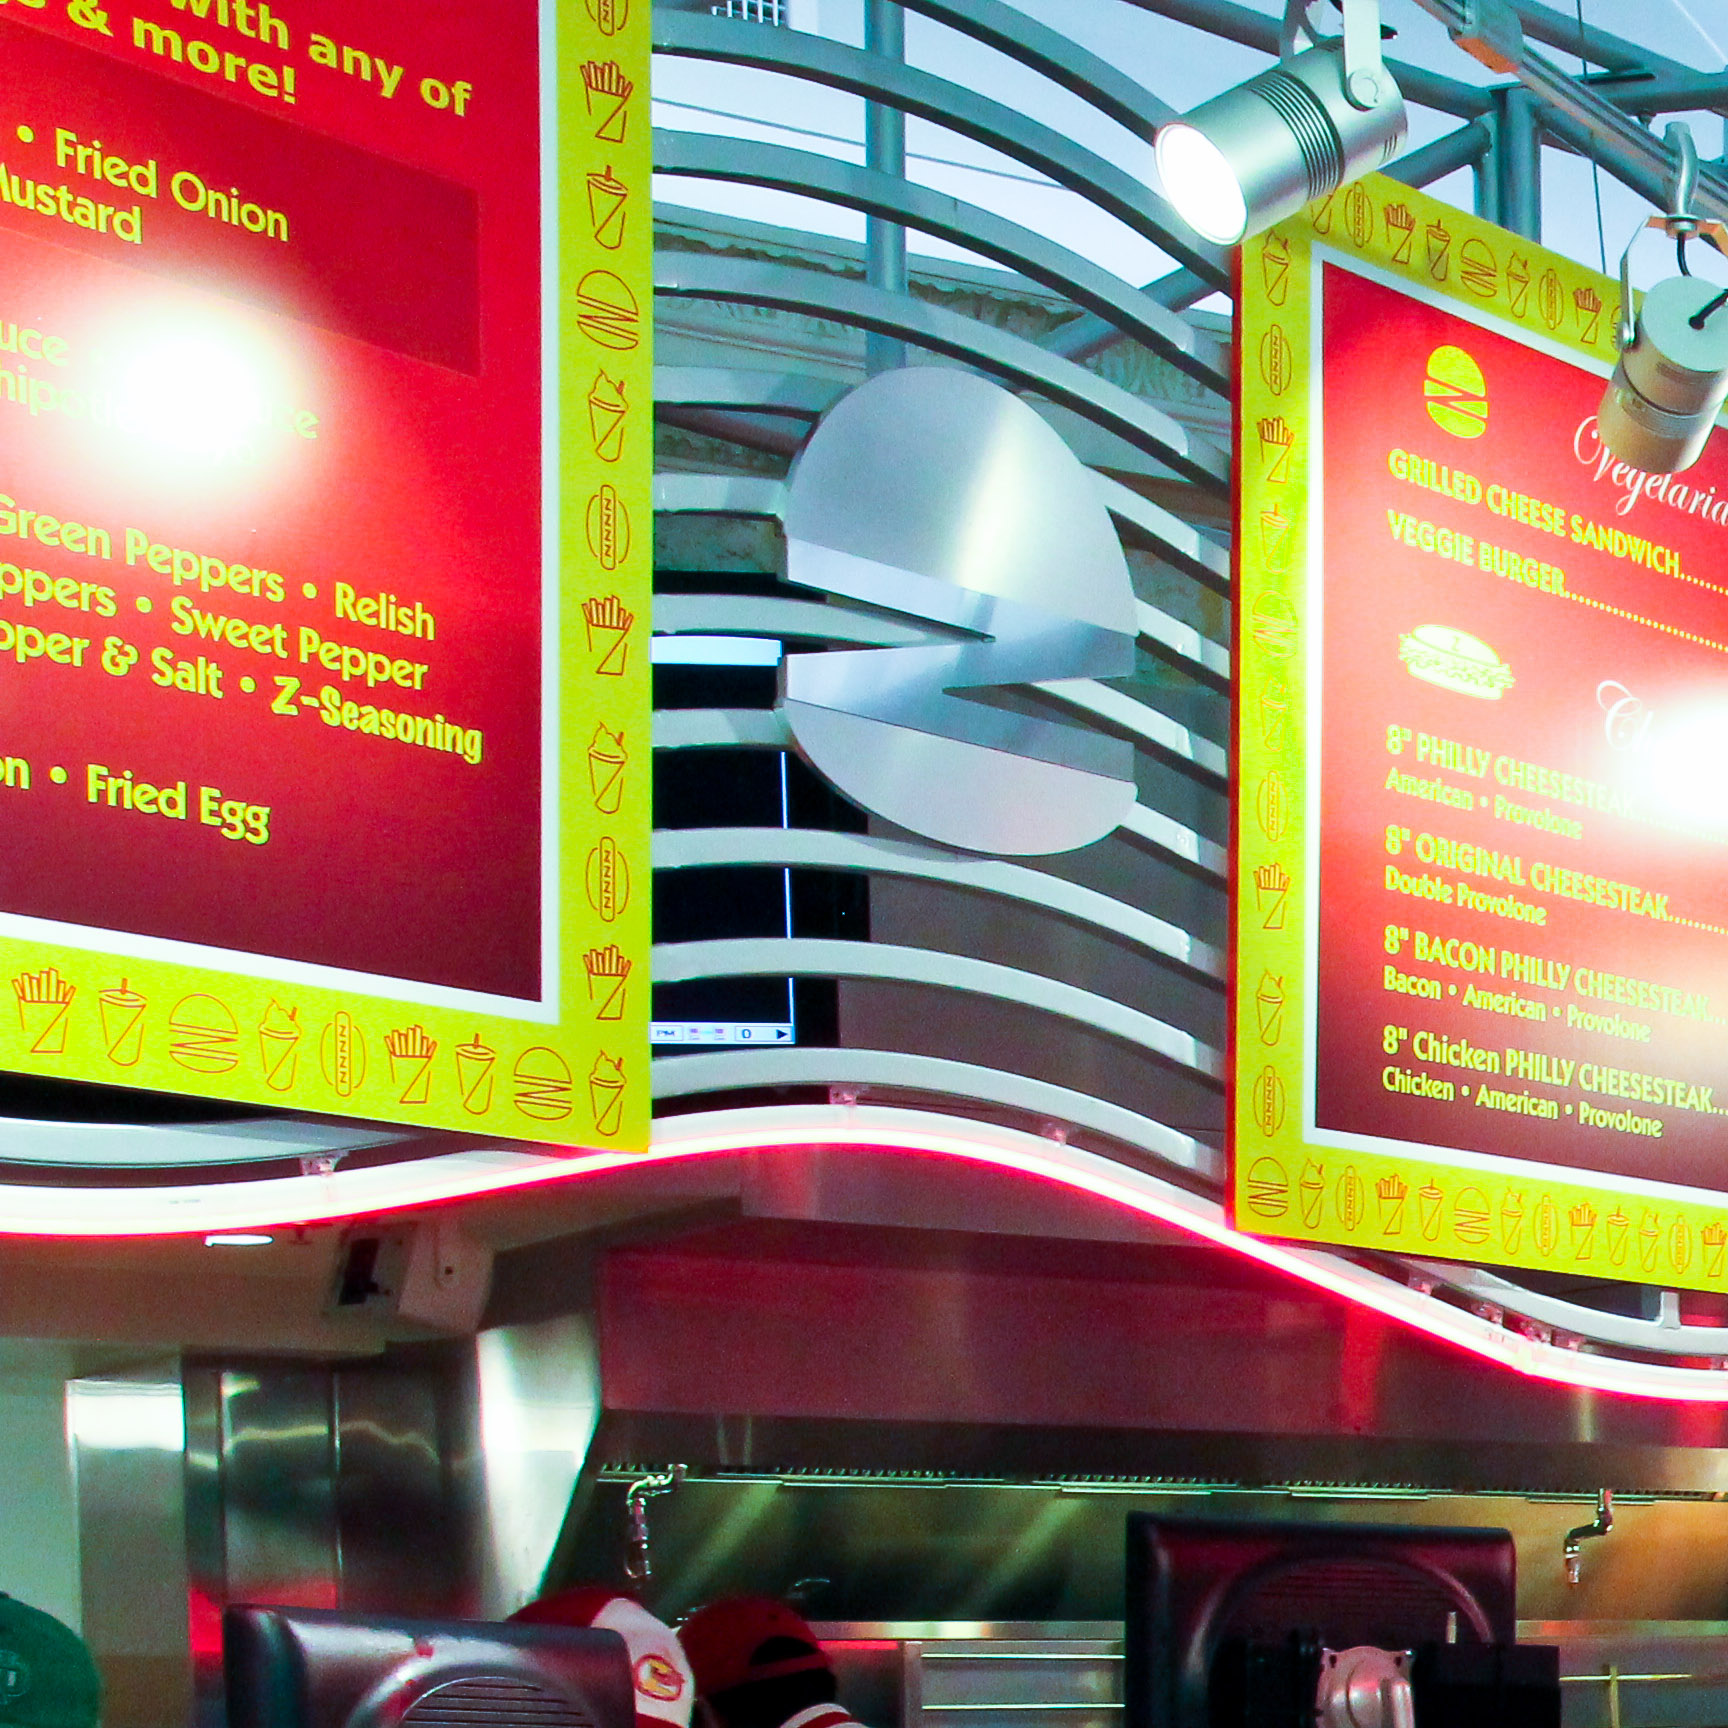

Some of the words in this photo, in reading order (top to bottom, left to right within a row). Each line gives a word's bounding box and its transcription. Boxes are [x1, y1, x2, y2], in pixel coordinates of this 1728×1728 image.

[132, 16, 297, 104] more!
[308, 33, 404, 98] any
[420, 76, 473, 117] of
[55, 127, 158, 198] Fried
[170, 171, 289, 241] Onion
[1387, 448, 1481, 506] GRILLED
[1487, 484, 1566, 538] CHEESE
[1571, 515, 1681, 578] SANDWICH
[1387, 508, 1474, 567] VEGGIE
[1479, 541, 1566, 598] BURGER
[125, 528, 285, 602] Peppers
[335, 582, 435, 640] Relish
[171, 596, 288, 658] Sweet
[299, 627, 429, 690] Pepper
[101, 635, 139, 676] &
[151, 647, 224, 698] Salt
[271, 676, 483, 764] Z-Seasoning
[87, 764, 187, 820] Fried
[200, 787, 271, 845] Egg
[1385, 767, 1473, 811] American
[1494, 794, 1583, 840] Provolone
[1386, 724, 1413, 755] 8"
[1416, 732, 1491, 778] PHILLY
[1494, 755, 1634, 818] CHEESESTEAK
[1384, 865, 1453, 904] Double
[1457, 884, 1547, 926] Provolone
[1385, 825, 1411, 855] 8"
[1415, 833, 1525, 886] ORIGINAL
[1530, 862, 1669, 922] CHEESESTEAK
[1384, 925, 1409, 955] 8"
[1415, 932, 1495, 975] BACON
[1501, 950, 1571, 992] PHILLY
[1574, 967, 1710, 1020] CHEESESTEAK
[1384, 966, 1441, 1000] Bacon
[1463, 984, 1546, 1022] American
[1567, 1004, 1651, 1043] Provolone
[1382, 1066, 1454, 1101] Chicken
[1476, 1084, 1559, 1120] American
[1579, 1102, 1664, 1138] Provolone
[1383, 1025, 1408, 1055] 8"
[1413, 1031, 1500, 1074] Chicken
[1506, 1048, 1575, 1087] PHILLY
[1578, 1064, 1713, 1114] CHEESESTEAK
